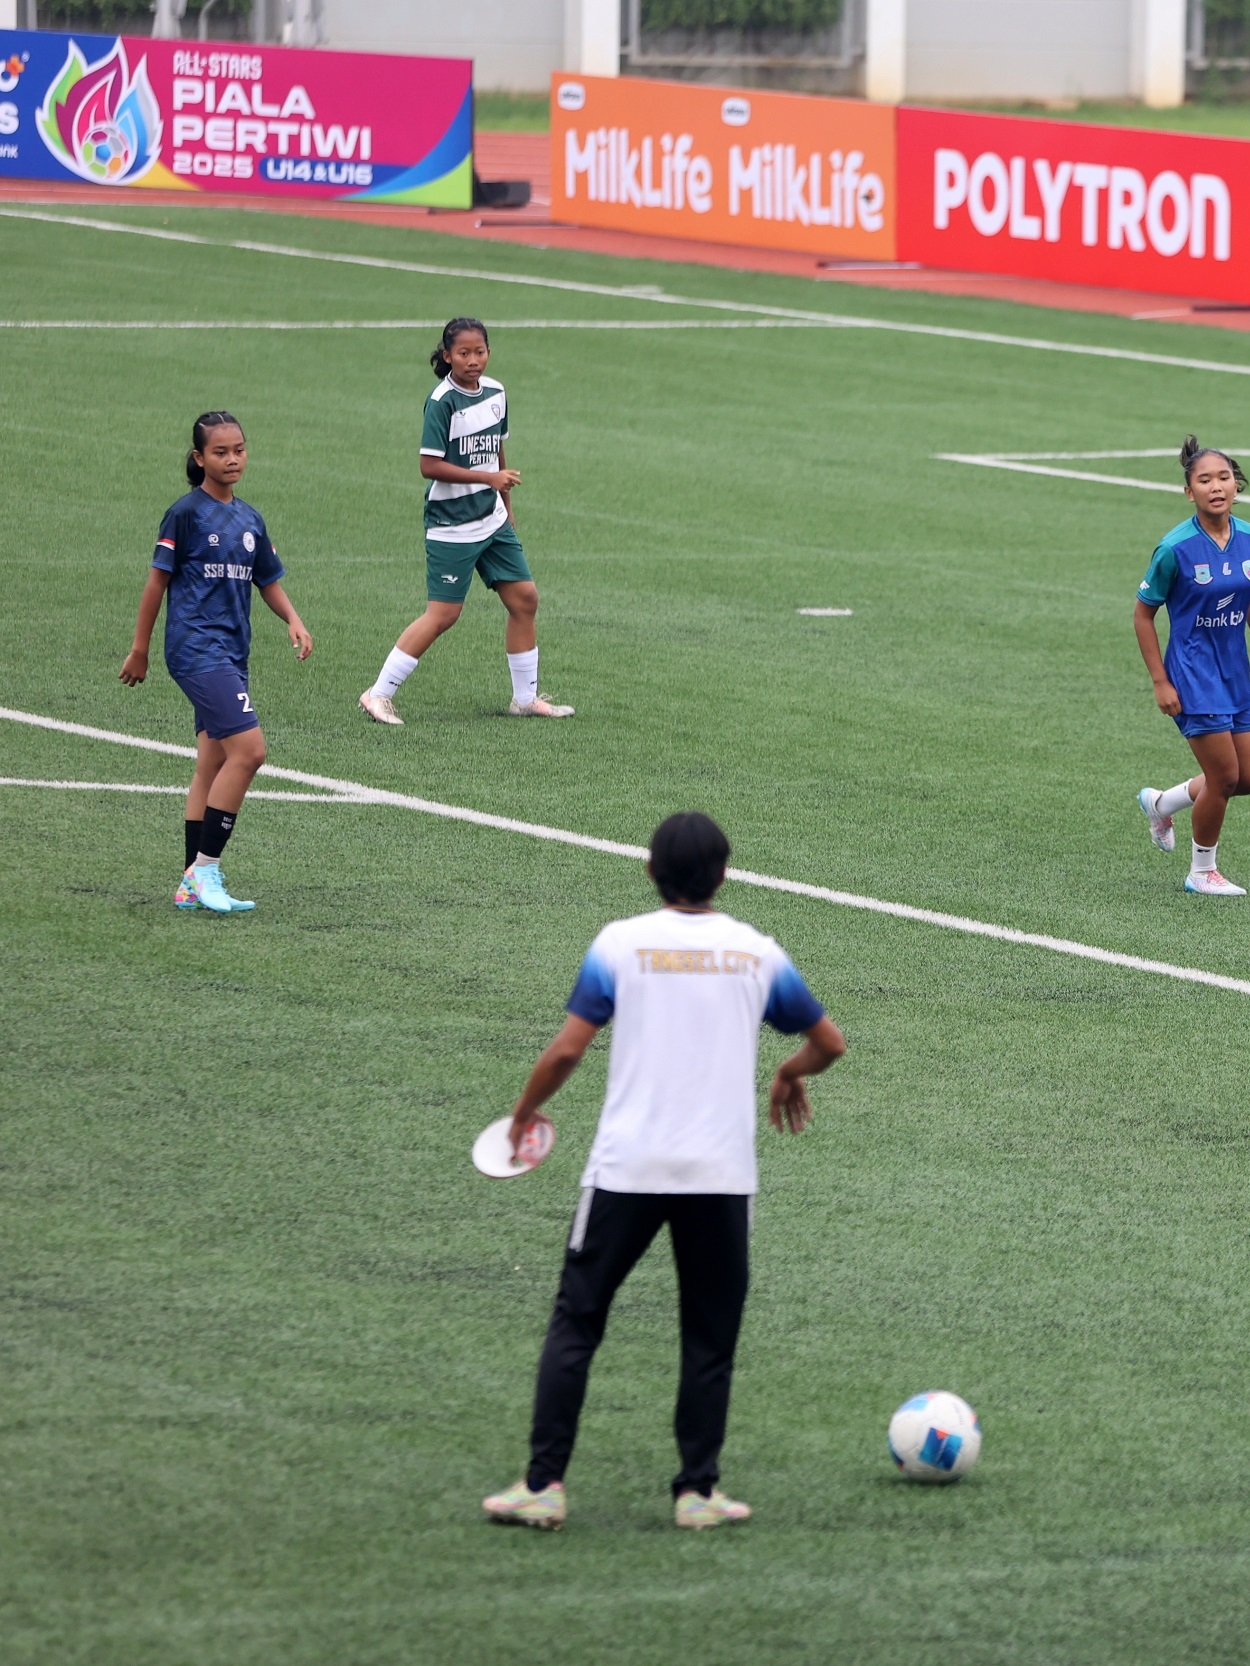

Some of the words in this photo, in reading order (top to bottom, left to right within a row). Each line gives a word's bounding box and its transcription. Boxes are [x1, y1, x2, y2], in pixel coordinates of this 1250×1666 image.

[208, 52, 263, 80] STARS
[173, 77, 316, 120] PIALA
[172, 114, 372, 160] PERTIWI
[173, 151, 254, 179] 2025
[564, 126, 713, 214] MilkLife
[729, 143, 885, 232] MilkLife
[933, 147, 1231, 262] POLYTRON
[204, 563, 224, 578] SSB
[1195, 613, 1228, 628] bank
[236, 692, 254, 713] 2
